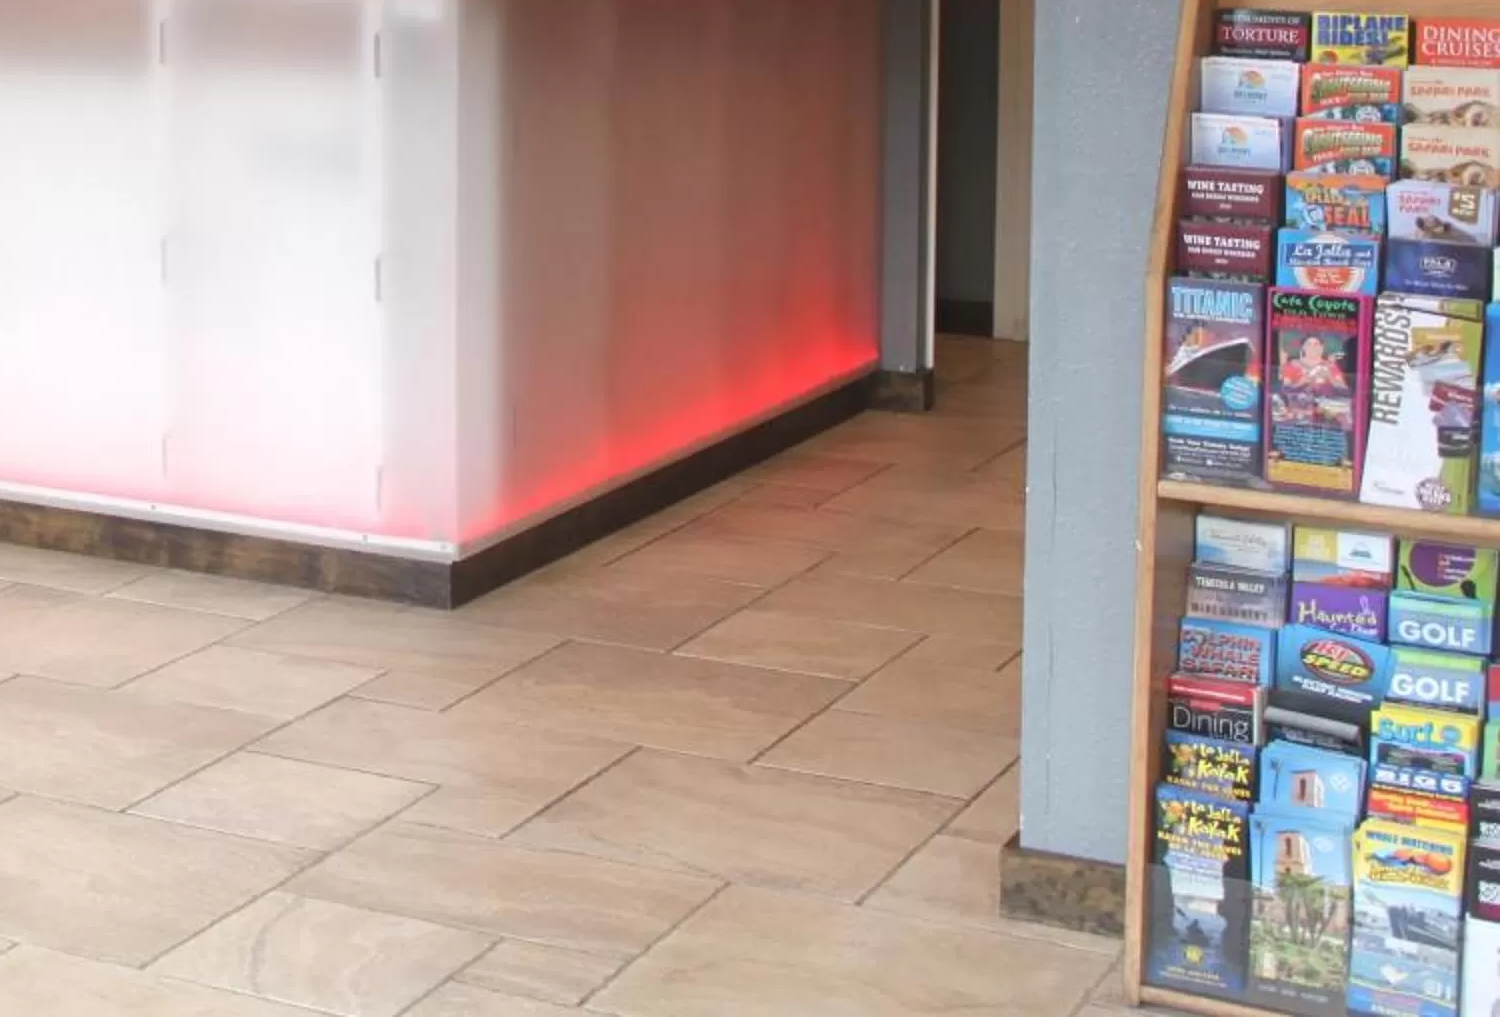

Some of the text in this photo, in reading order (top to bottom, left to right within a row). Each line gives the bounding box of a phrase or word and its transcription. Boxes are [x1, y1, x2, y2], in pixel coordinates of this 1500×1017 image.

[1316, 13, 1406, 32] BIPLANE
[1221, 26, 1301, 45] TORTURE
[1422, 24, 1500, 44] DINING
[1420, 41, 1500, 59] CRUISES
[1187, 180, 1265, 195] WINE TASTING
[1183, 233, 1261, 251] WINE TASTING
[1292, 244, 1313, 257] La
[1315, 244, 1352, 261] Jolla
[1171, 286, 1254, 320] TITANIC
[1273, 293, 1358, 313] Cafe Coyote
[1297, 598, 1377, 626] Haunted
[1398, 619, 1477, 648] GOLF
[1192, 645, 1260, 664] WHALE
[1180, 658, 1258, 681] SAFARI
[1301, 654, 1370, 679] SPEED
[1390, 672, 1470, 704] GOLF
[1173, 705, 1250, 742] Dining
